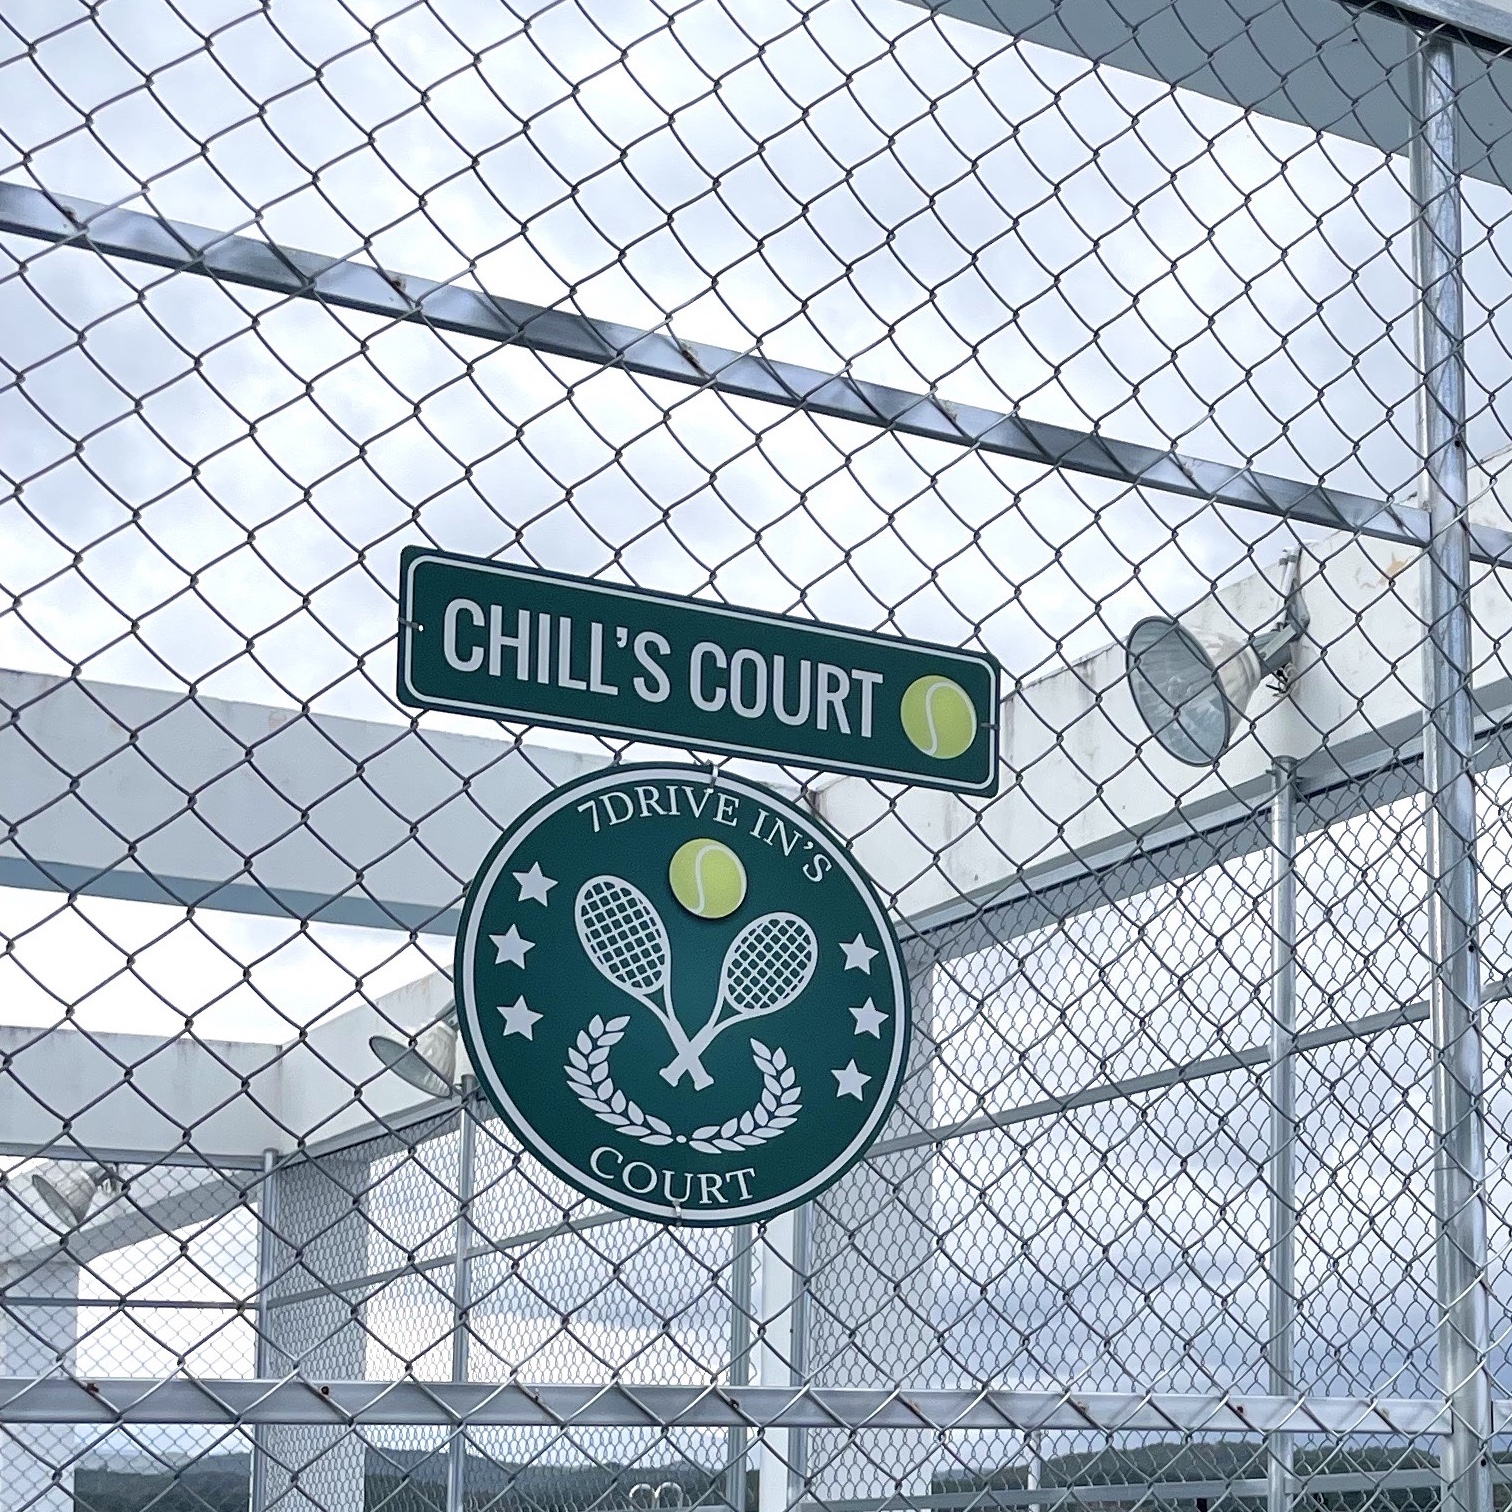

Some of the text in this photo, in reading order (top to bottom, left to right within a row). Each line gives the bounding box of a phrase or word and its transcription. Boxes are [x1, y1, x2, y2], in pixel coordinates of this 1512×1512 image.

[443, 597, 884, 739] CHILL'S COURT
[577, 785, 833, 883] 7DRIVE IN'S
[589, 1146, 757, 1205] COURT
